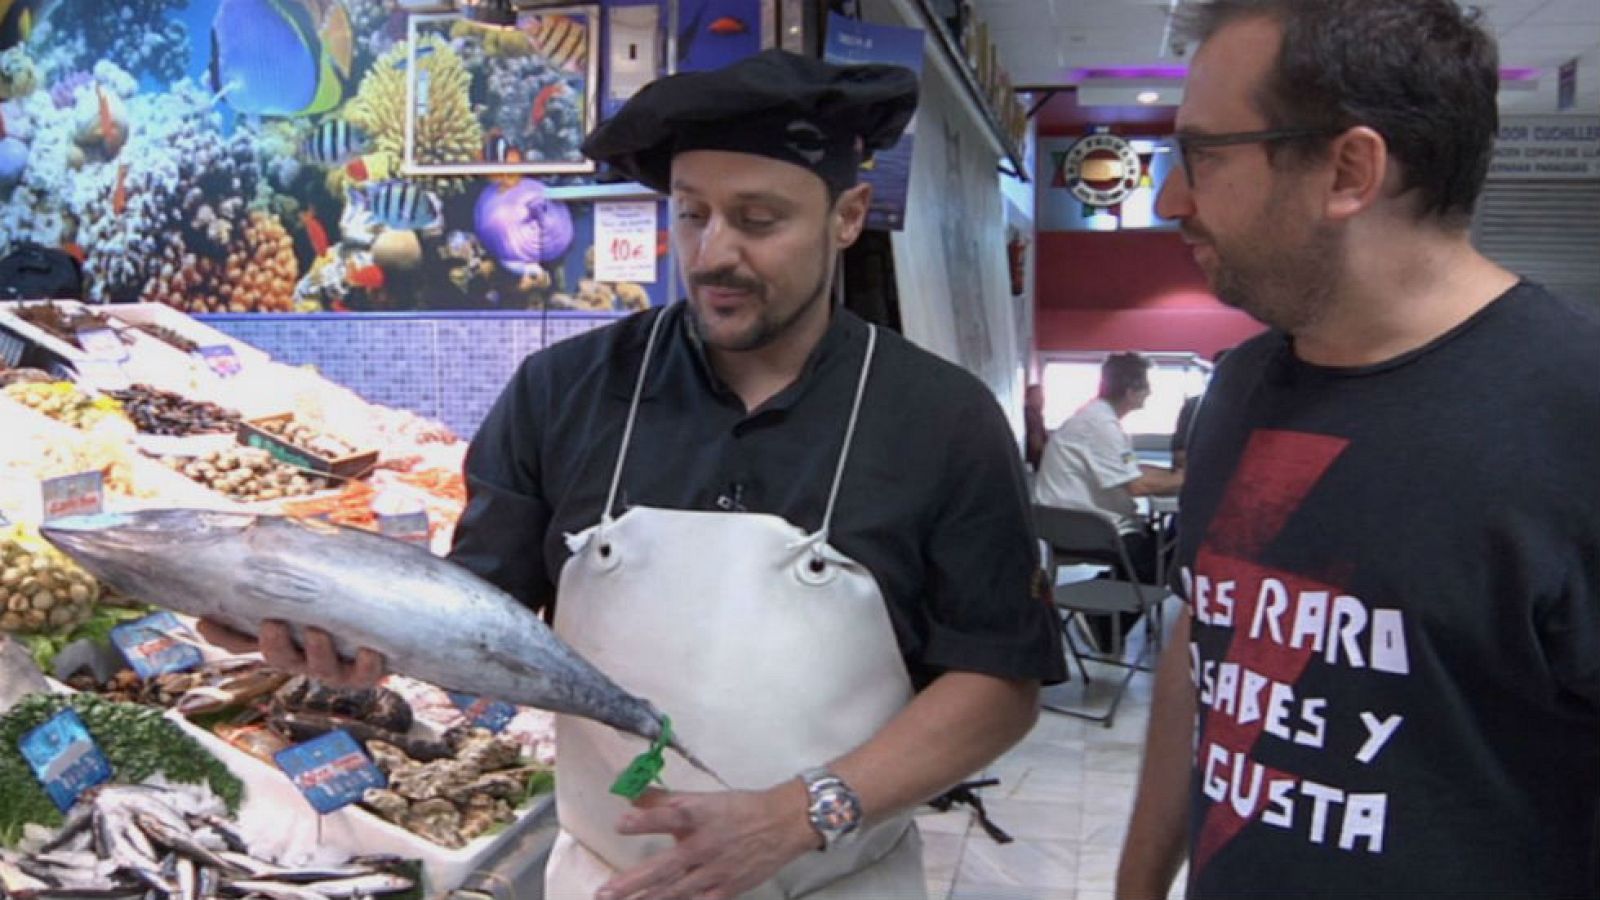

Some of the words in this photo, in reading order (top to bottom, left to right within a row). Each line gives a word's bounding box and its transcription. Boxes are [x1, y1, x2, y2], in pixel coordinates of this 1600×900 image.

[1502, 126, 1528, 140] DOR
[1248, 577, 1410, 676] RARO
[1200, 660, 1328, 749] SABES
[1354, 711, 1404, 764] Y
[1202, 742, 1389, 854] GUSTA
